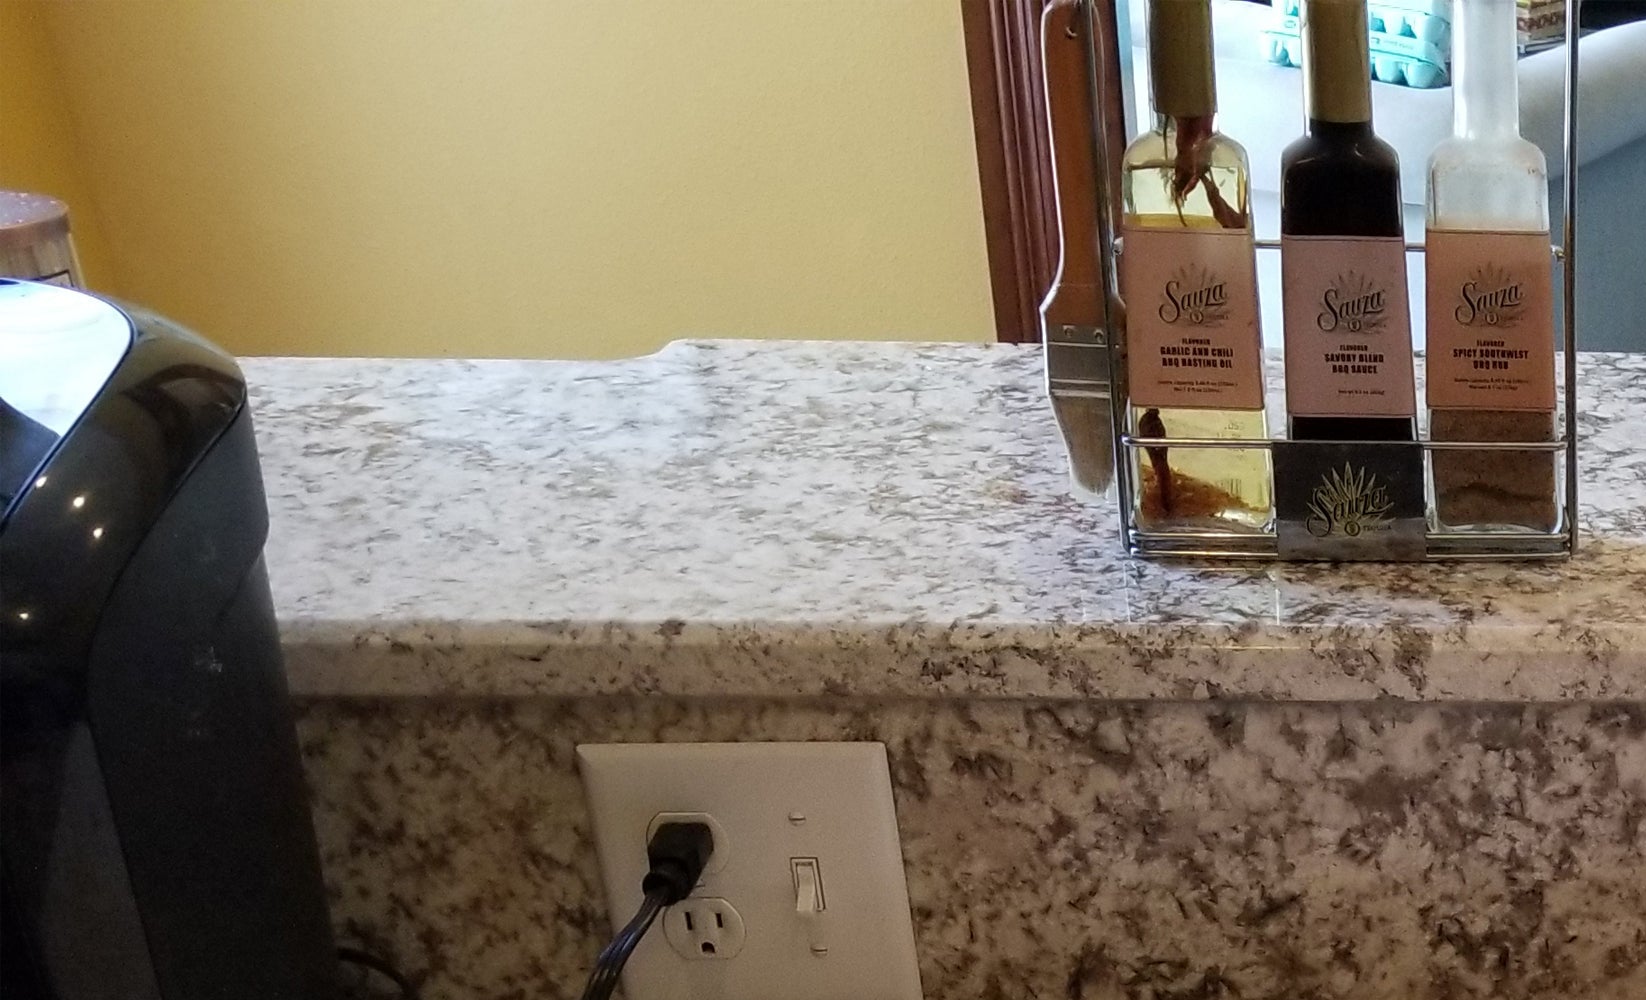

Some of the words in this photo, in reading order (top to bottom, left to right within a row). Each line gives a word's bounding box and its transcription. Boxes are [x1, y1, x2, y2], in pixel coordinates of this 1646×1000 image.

[1159, 280, 1228, 324] Sauza
[1455, 281, 1523, 325] Sauza
[1317, 289, 1385, 332] Sauza
[1160, 346, 1190, 355] GARLIC
[1192, 347, 1209, 357] AND
[1211, 348, 1234, 358] CHILI
[1453, 349, 1477, 358] SPICY
[1480, 349, 1529, 359] SOUTHWEST
[1162, 357, 1180, 367] BBQ
[1181, 358, 1218, 368] BASTING
[1220, 359, 1233, 369] OIL
[1324, 354, 1357, 363] SAVORY
[1359, 354, 1384, 363] BLEND
[1332, 364, 1349, 374] BBQ
[1351, 365, 1378, 374] SAUCE
[1305, 485, 1389, 537] Sauza
